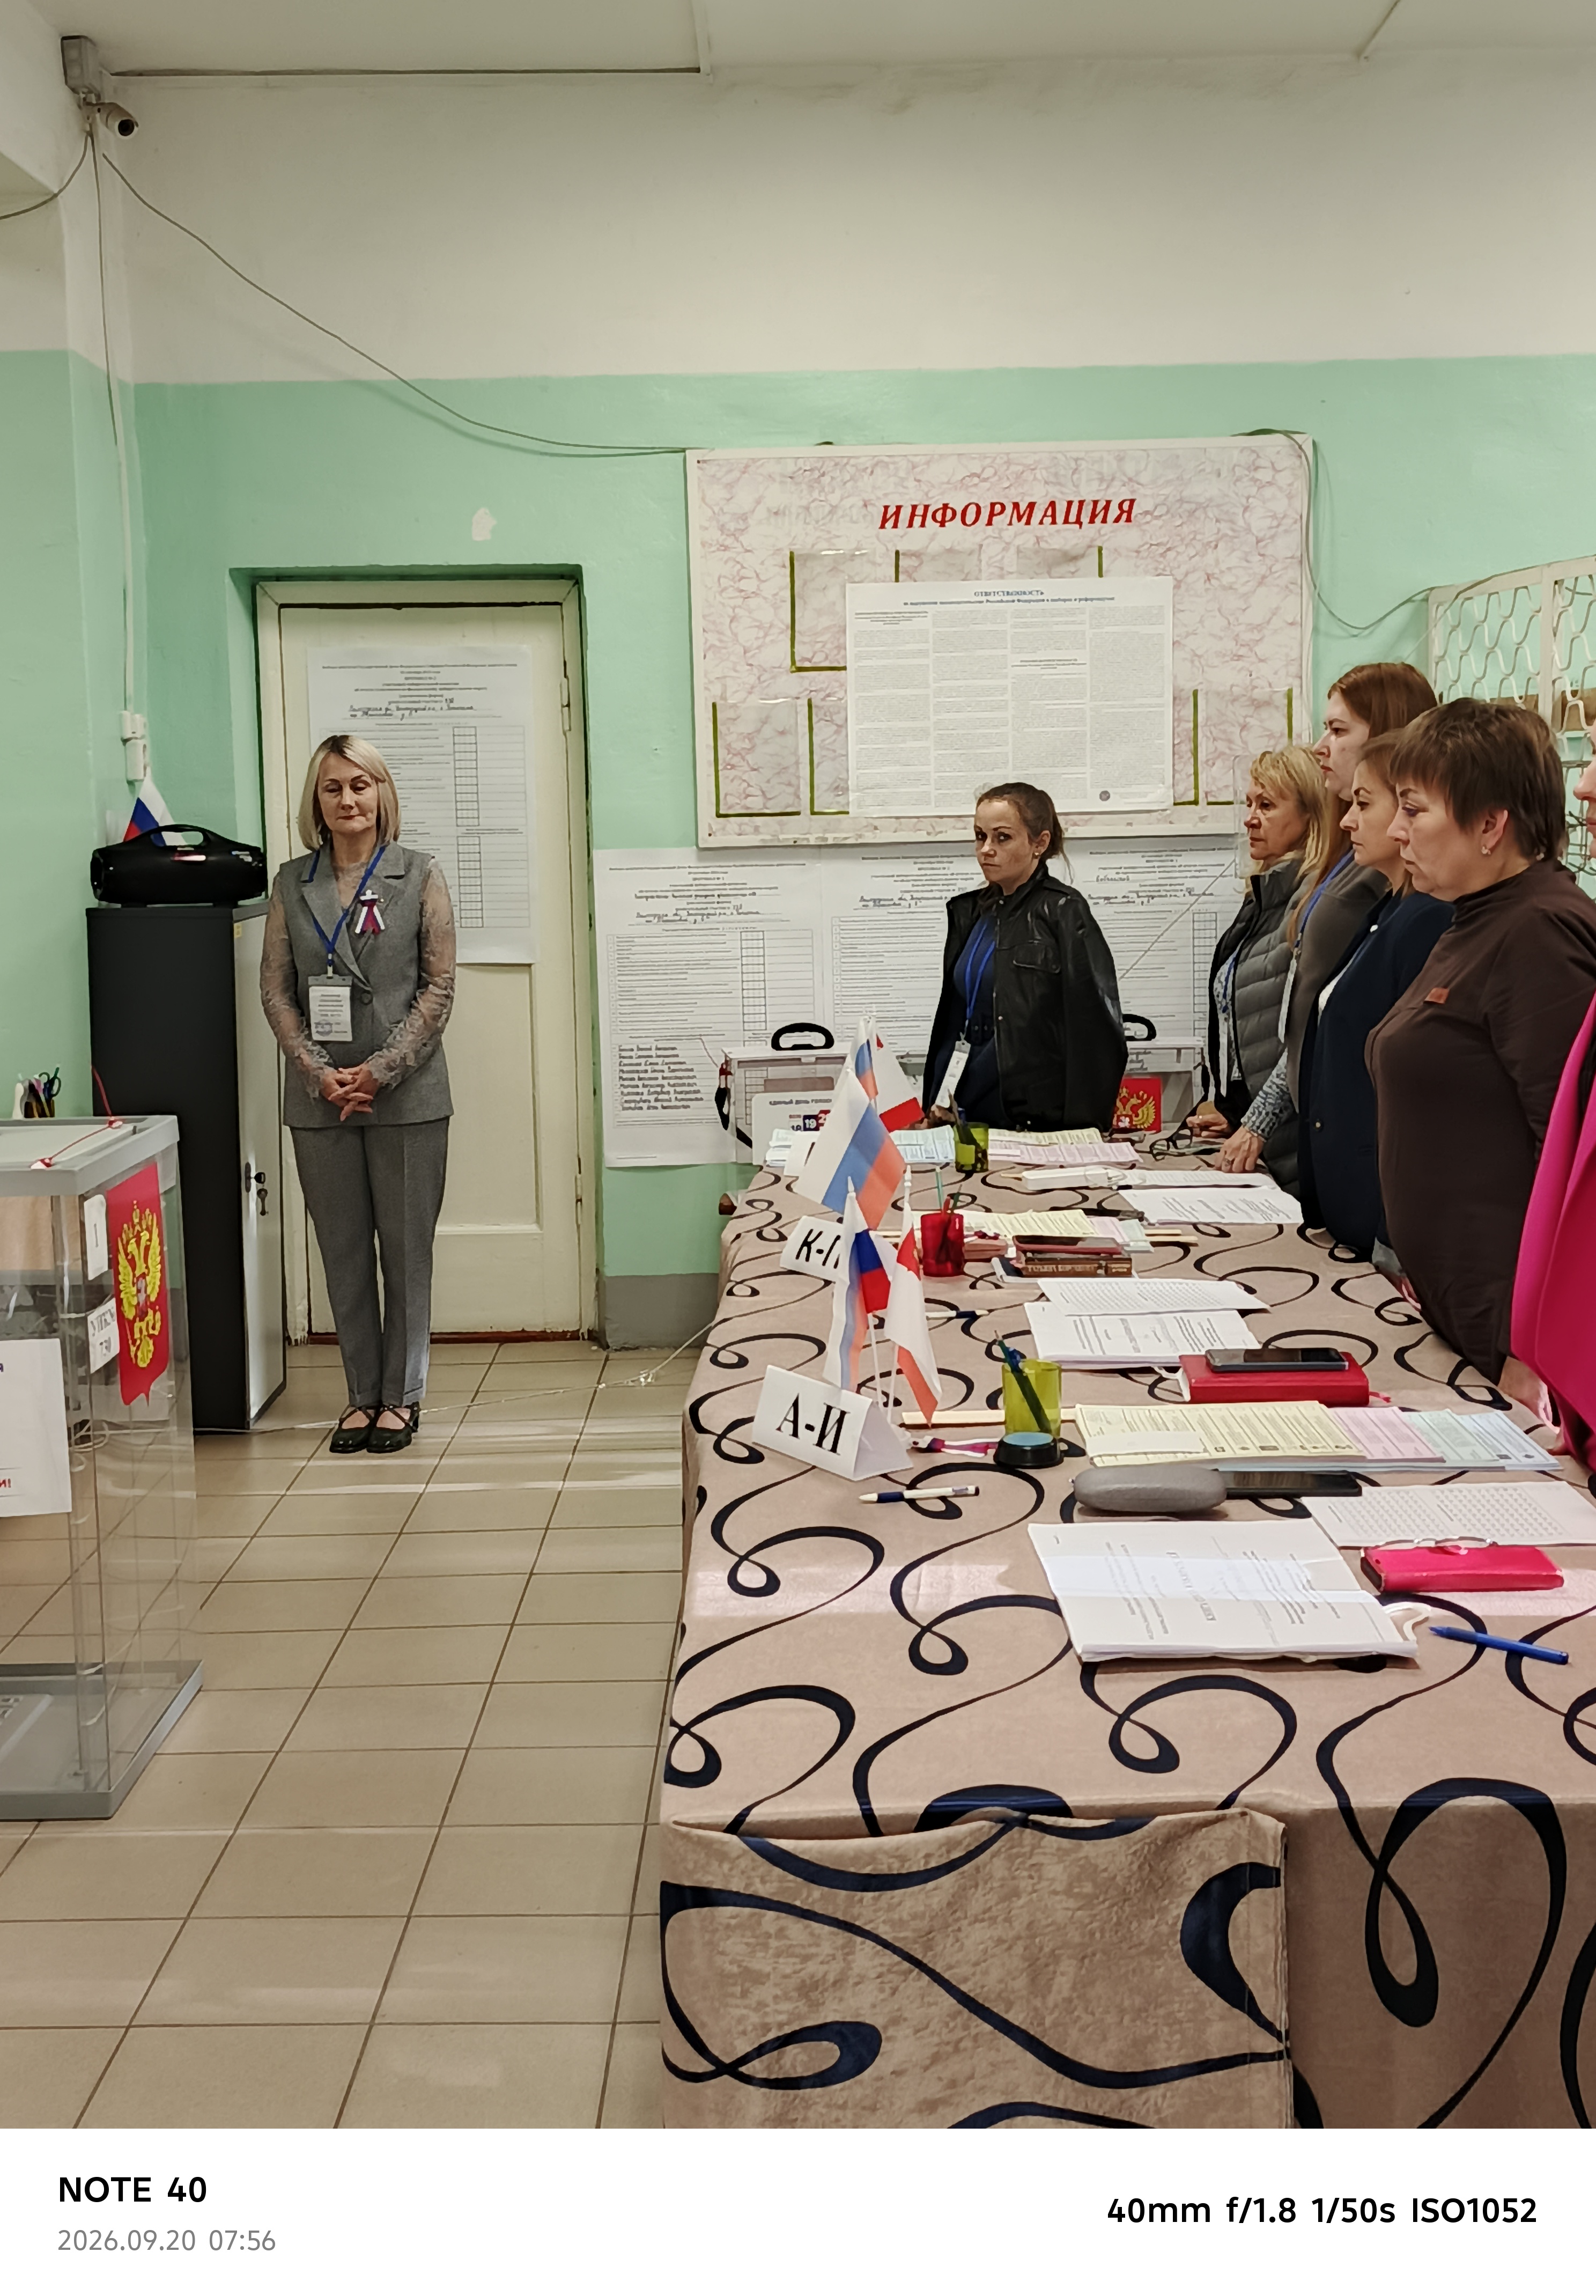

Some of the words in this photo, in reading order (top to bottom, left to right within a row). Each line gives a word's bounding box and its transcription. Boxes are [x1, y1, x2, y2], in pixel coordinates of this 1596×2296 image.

[878, 498, 1137, 530] ИНФОРМАЦИЯ
[804, 1118, 817, 1129] 19
[775, 1393, 851, 1455] А-И
